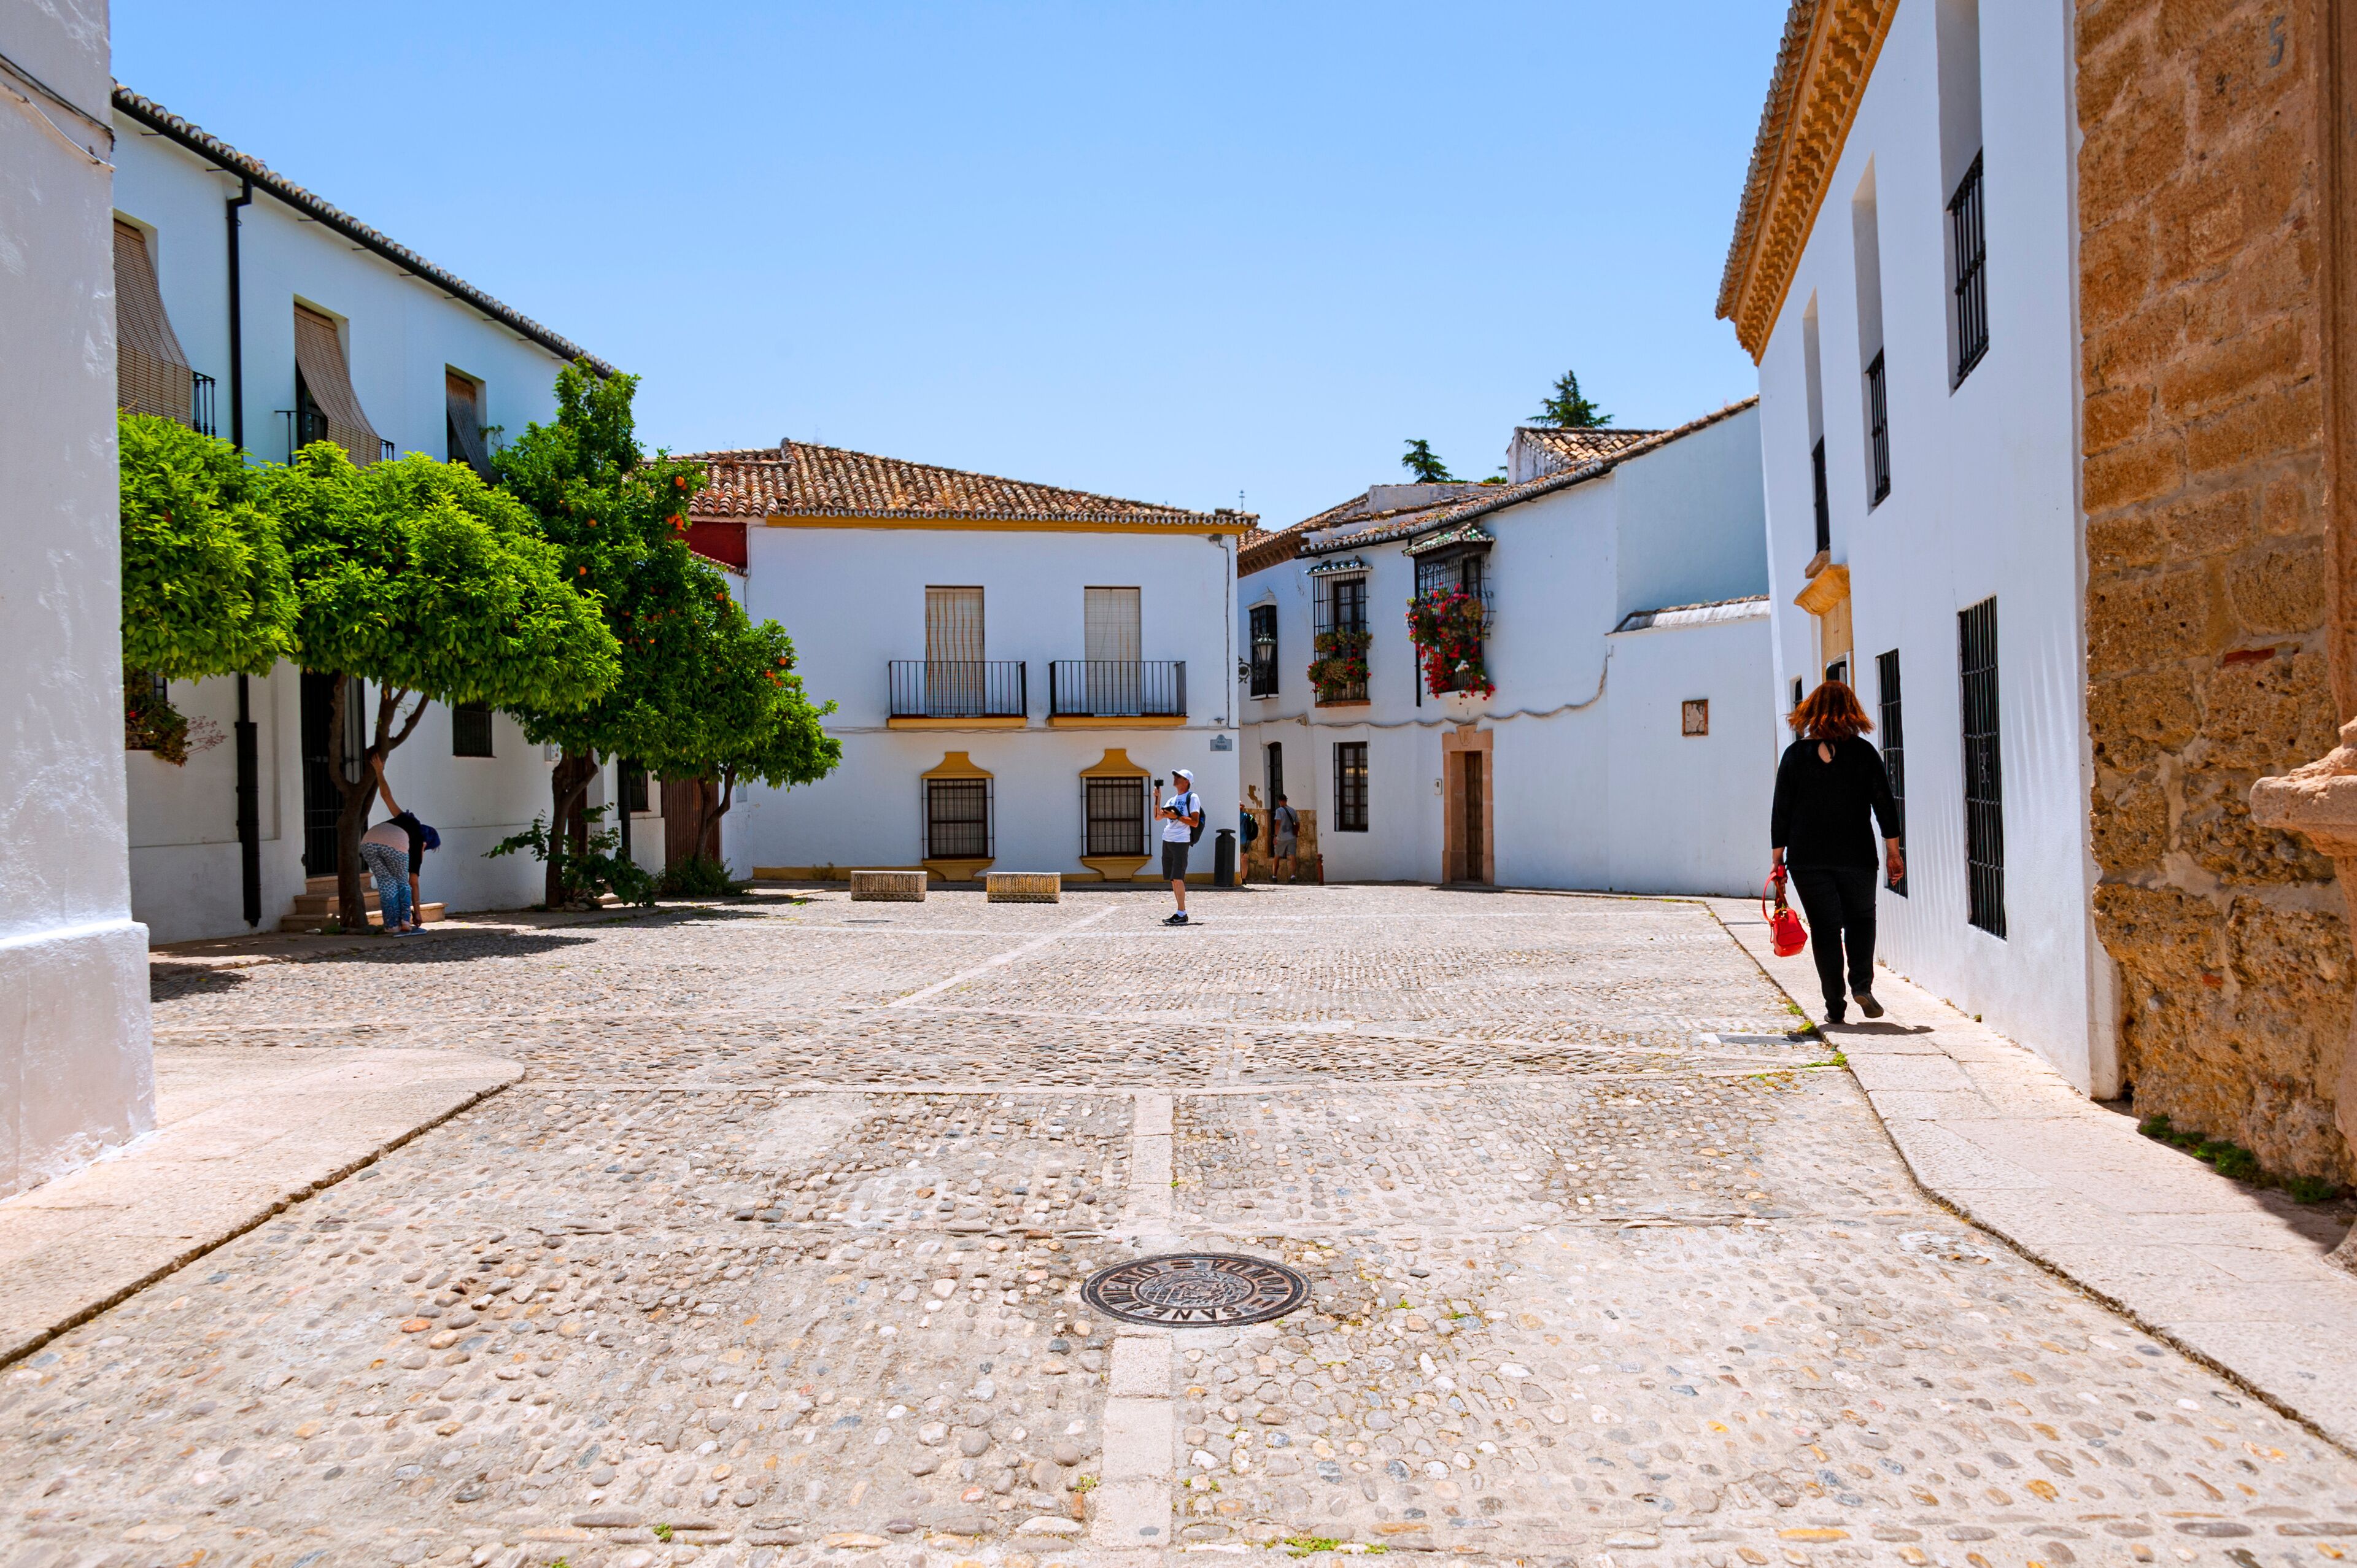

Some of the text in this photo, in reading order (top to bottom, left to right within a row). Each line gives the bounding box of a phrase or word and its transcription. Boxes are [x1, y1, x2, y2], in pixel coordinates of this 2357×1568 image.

[2269, 15, 2285, 69] 5
[1102, 1259, 1290, 1320] SANEAMIENTO RONDA
